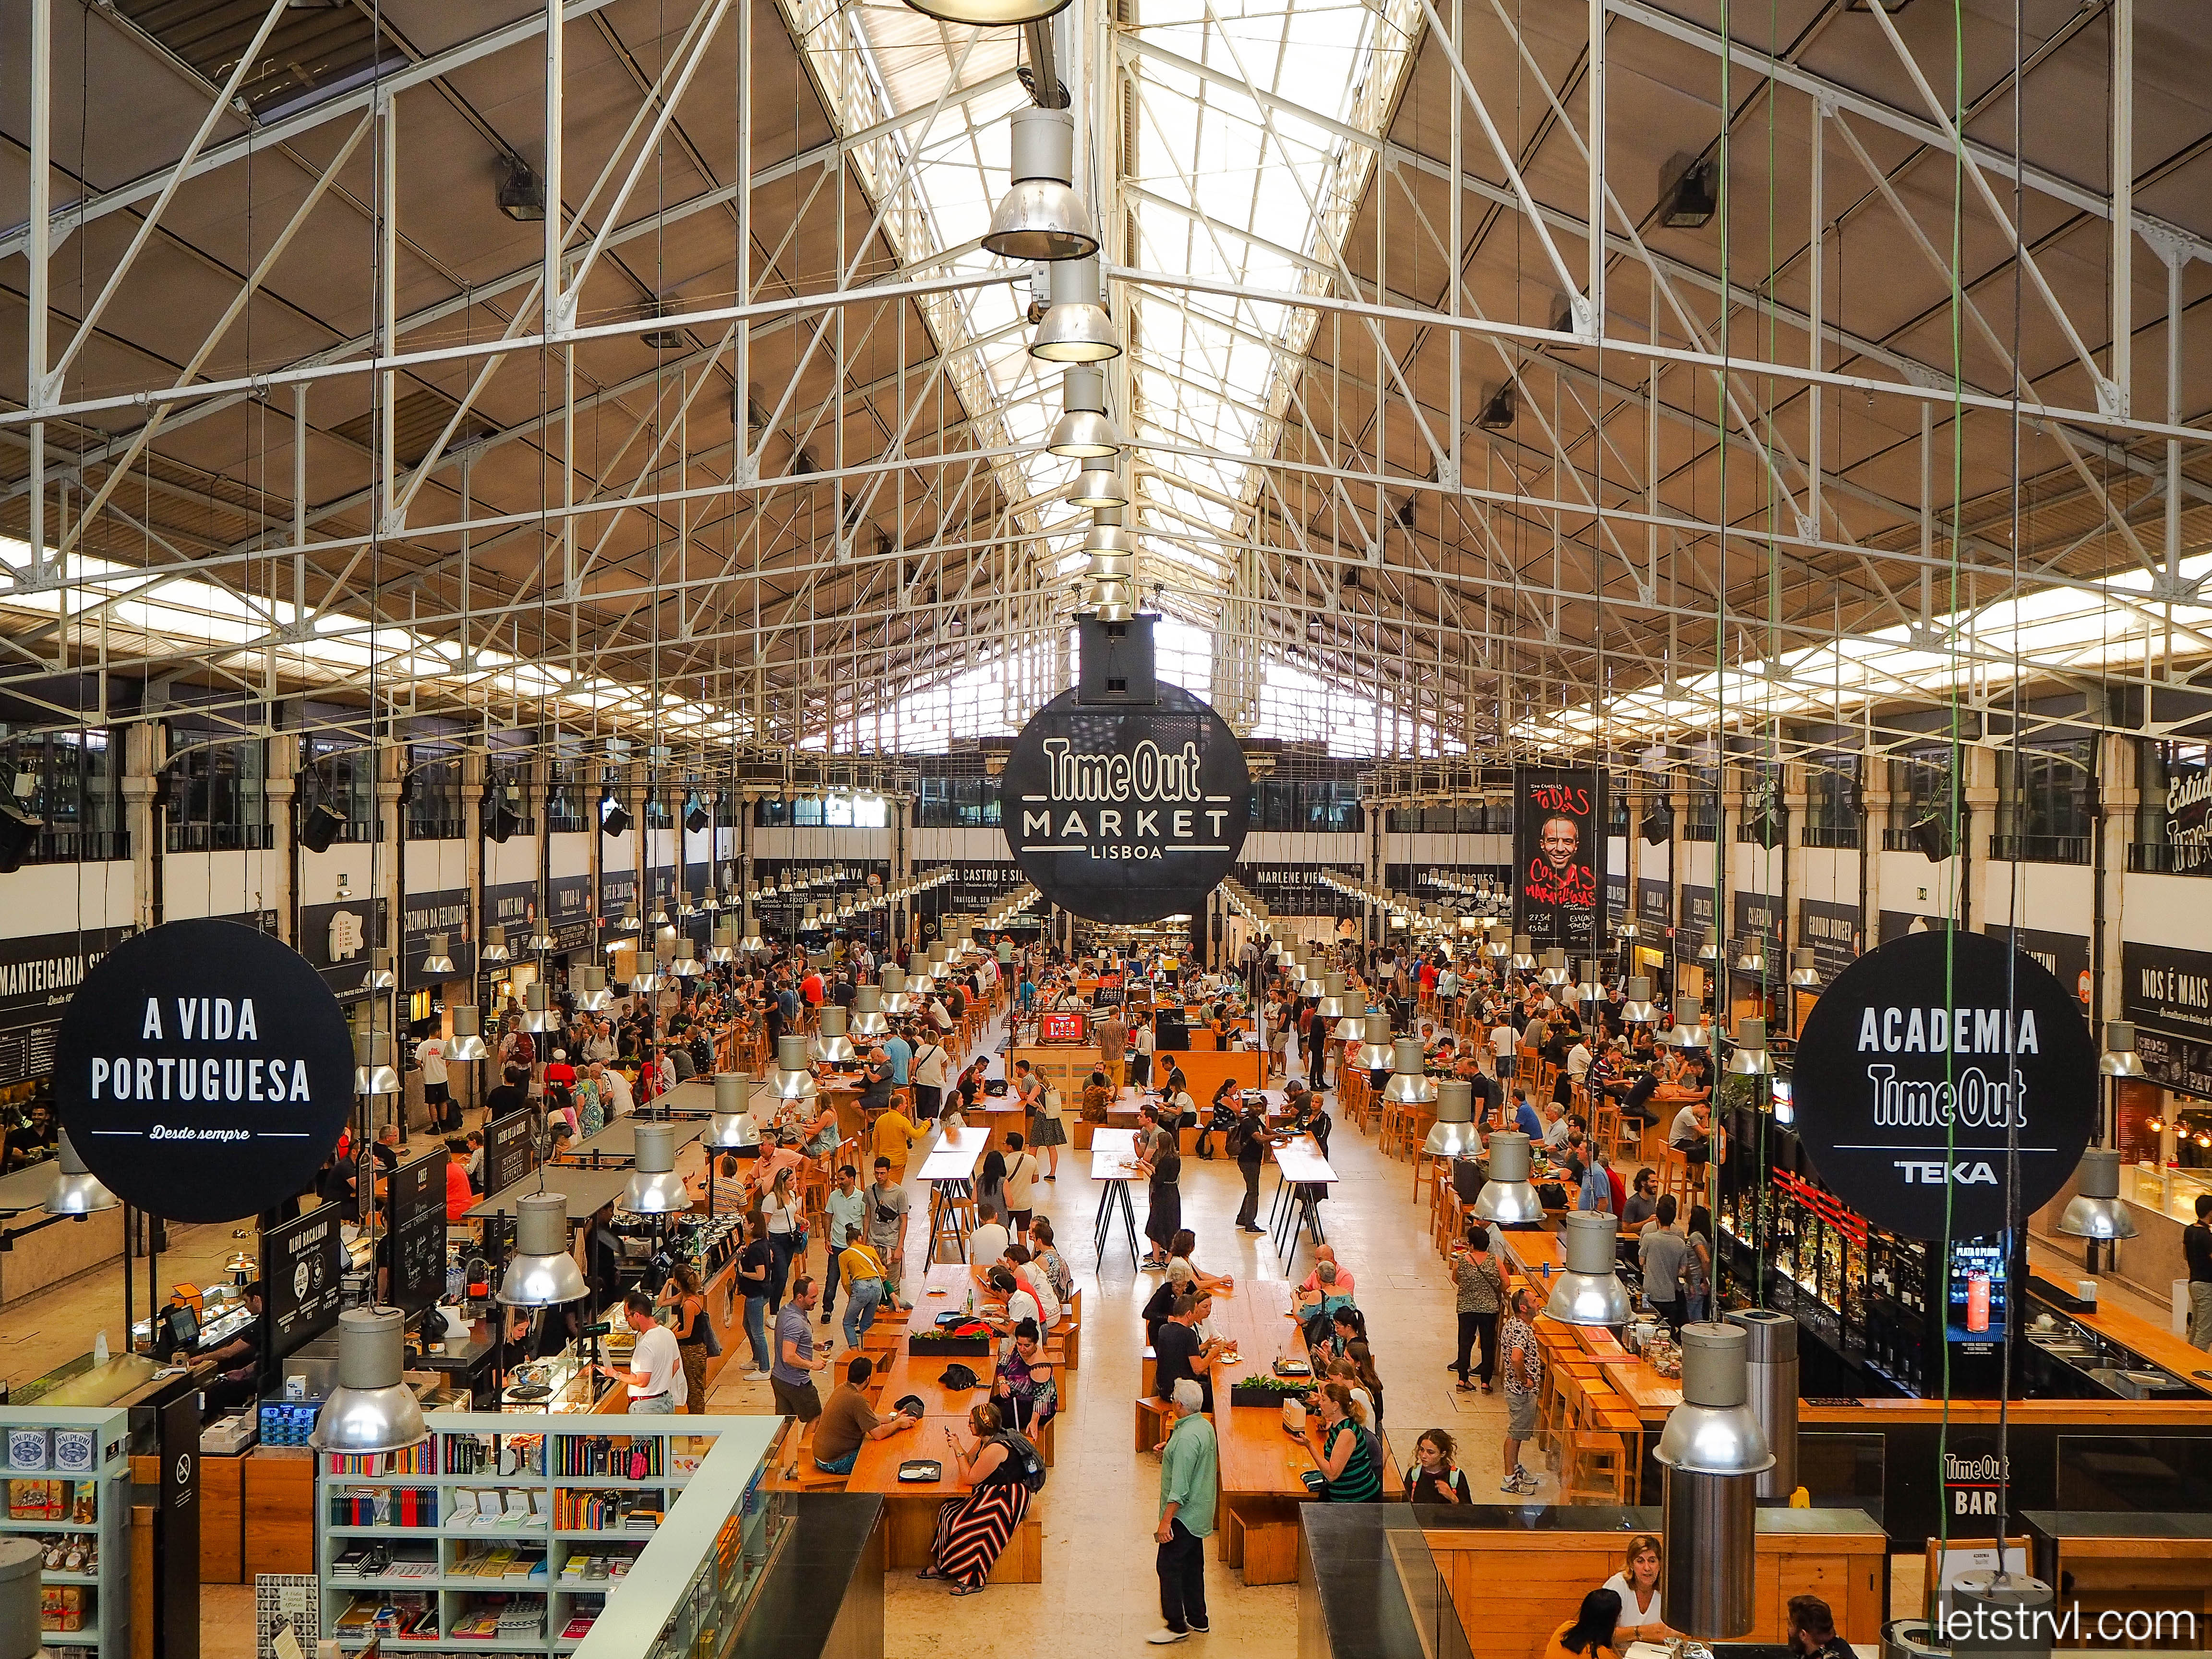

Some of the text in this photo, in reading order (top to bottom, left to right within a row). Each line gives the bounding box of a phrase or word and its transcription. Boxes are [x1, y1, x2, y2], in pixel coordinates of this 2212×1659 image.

[1022, 810, 1229, 837] MARKET
[1091, 845, 1163, 860] LISBOA
[963, 869, 998, 881] CASTRO
[1002, 870, 1007, 881] E
[1258, 872, 1300, 883] MARLENE
[404, 909, 428, 933] COZINHA
[430, 908, 438, 928] DA
[1808, 915, 1852, 942] GROUND BURGER
[0, 955, 84, 997] MANTEIGARIA
[2167, 967, 2175, 1002] É
[2178, 974, 2209, 1009] MAIS
[143, 998, 258, 1040] A VIDA
[1857, 1007, 2039, 1054] ACADEMIA
[91, 1058, 310, 1102] PORTUGUESA
[149, 1125, 251, 1142] Desde sempre
[418, 1167, 427, 1184] CHEF
[1894, 1160, 1998, 1184] TEKA
[289, 1231, 302, 1254] OLHÓ
[303, 1221, 328, 1247] BACALHAU
[1956, 1248, 1974, 1257] PLATA
[1955, 1491, 1997, 1515] BAR
